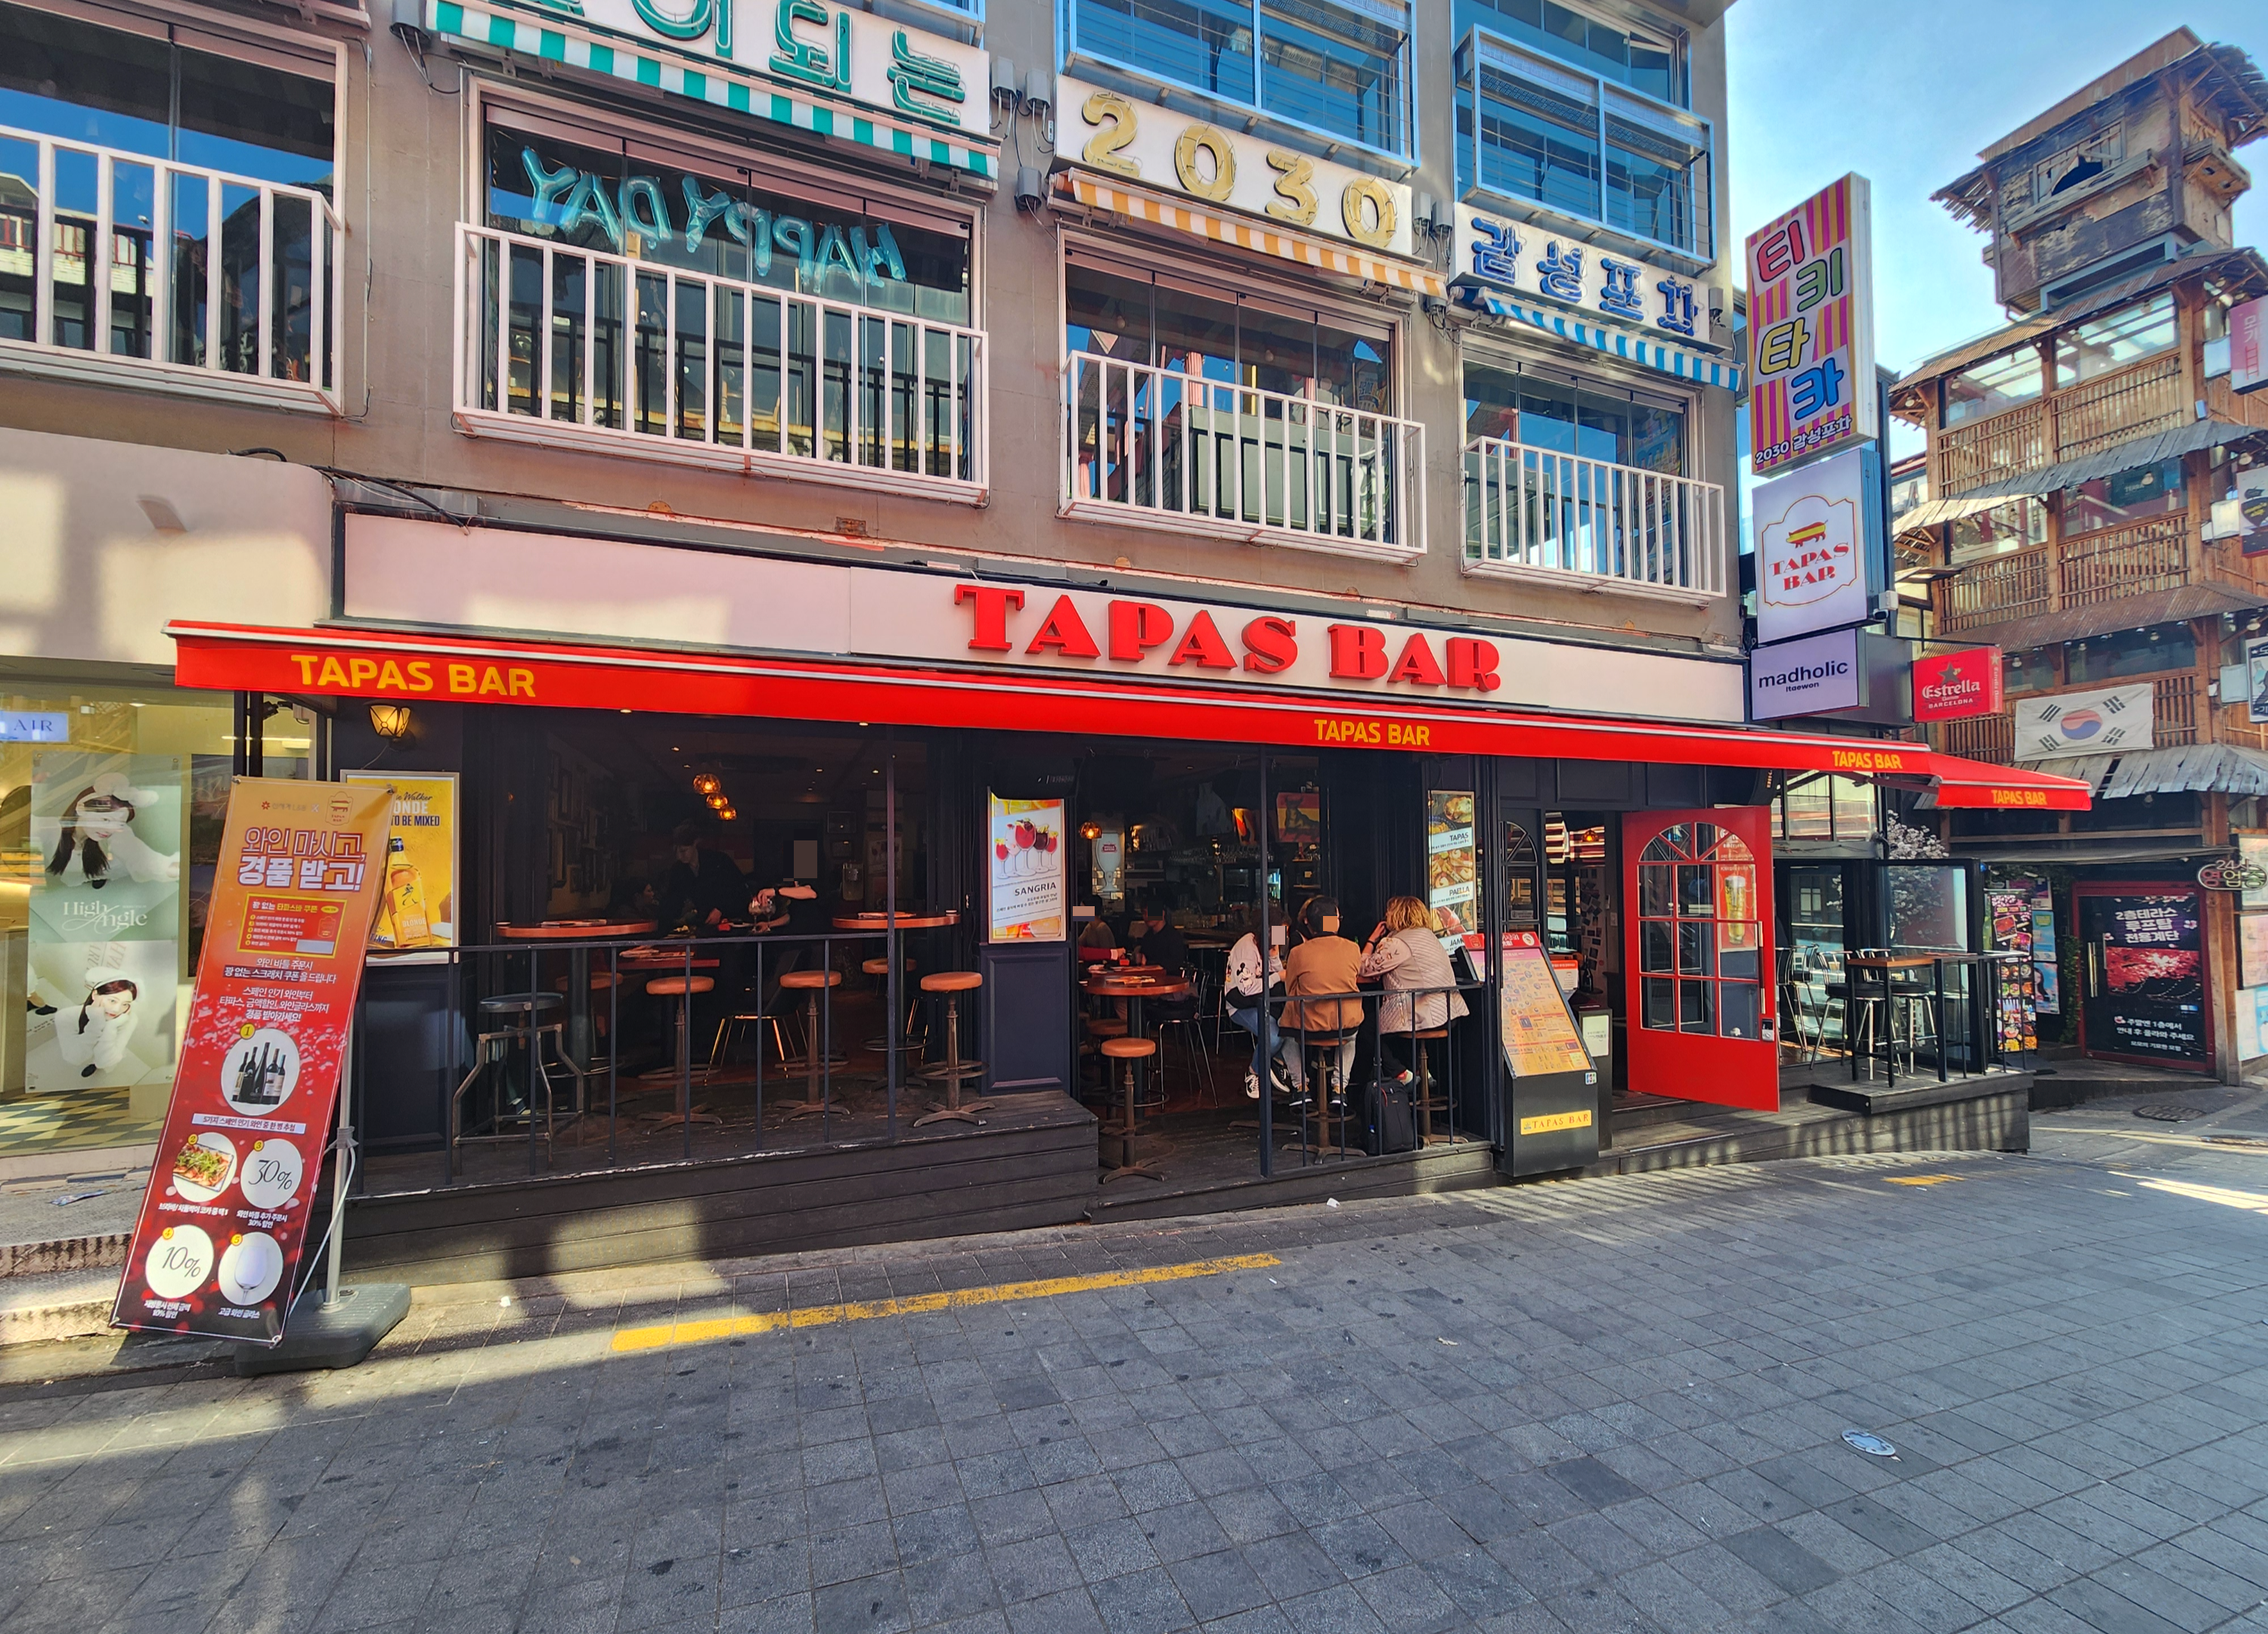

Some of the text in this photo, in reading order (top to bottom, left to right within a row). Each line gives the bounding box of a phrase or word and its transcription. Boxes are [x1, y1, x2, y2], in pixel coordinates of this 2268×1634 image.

[1081, 91, 1399, 248] 2030
[1755, 441, 1790, 465] 2030
[1769, 542, 1850, 577] TAPAS
[1783, 565, 1836, 591] BAR
[953, 583, 1501, 694] TAPAS BAR
[290, 654, 536, 698] TAPAS BAR
[1758, 660, 1849, 689] madholic
[1786, 682, 1820, 692] Itaewon
[1922, 679, 1981, 699] Estrella
[1929, 698, 1973, 709] BARCELONA
[1313, 719, 1430, 747] TAPAS BAR
[1832, 750, 1903, 769] TAPAS BAR
[404, 791, 432, 802] Walker
[1991, 789, 2047, 806] TAPAS BAR
[393, 800, 428, 814] ONDE
[401, 815, 412, 826] BE
[414, 815, 440, 827] MIXED
[1449, 832, 1469, 842] TAPAS
[242, 828, 367, 862] 와인 마시고,
[2216, 857, 2249, 871] 24시
[238, 855, 366, 892] 경품 받고!
[2201, 869, 2264, 888] 영업중
[1015, 882, 1056, 896] SANGRIA
[1449, 887, 1470, 897] PAELLA
[64, 900, 108, 917] High
[2115, 907, 2179, 921] 2층테라스
[2125, 918, 2174, 932] 루프탑
[370, 933, 388, 945] TING
[1450, 937, 1464, 946] JAM
[2124, 930, 2181, 943] 전용계단
[256, 958, 273, 967] 와인
[291, 960, 313, 970] 주문시
[234, 967, 251, 978] 없는
[251, 969, 283, 979] 스크래치
[308, 973, 336, 984] 드립니다
[243, 986, 313, 1001] 스페인 인기 와인부터
[245, 1008, 262, 1020] 경품
[244, 1026, 250, 1036] 1
[219, 1117, 237, 1126] 스페인
[238, 1119, 250, 1128] 인기
[250, 1119, 263, 1128] 와인
[270, 1122, 276, 1130] 한
[1532, 1114, 1588, 1129] TAPAS BAR
[190, 1135, 197, 1143] 2
[256, 1141, 262, 1150] 3
[248, 1159, 293, 1190] 30%
[234, 1236, 240, 1244] 5
[162, 1246, 201, 1278] 10%
